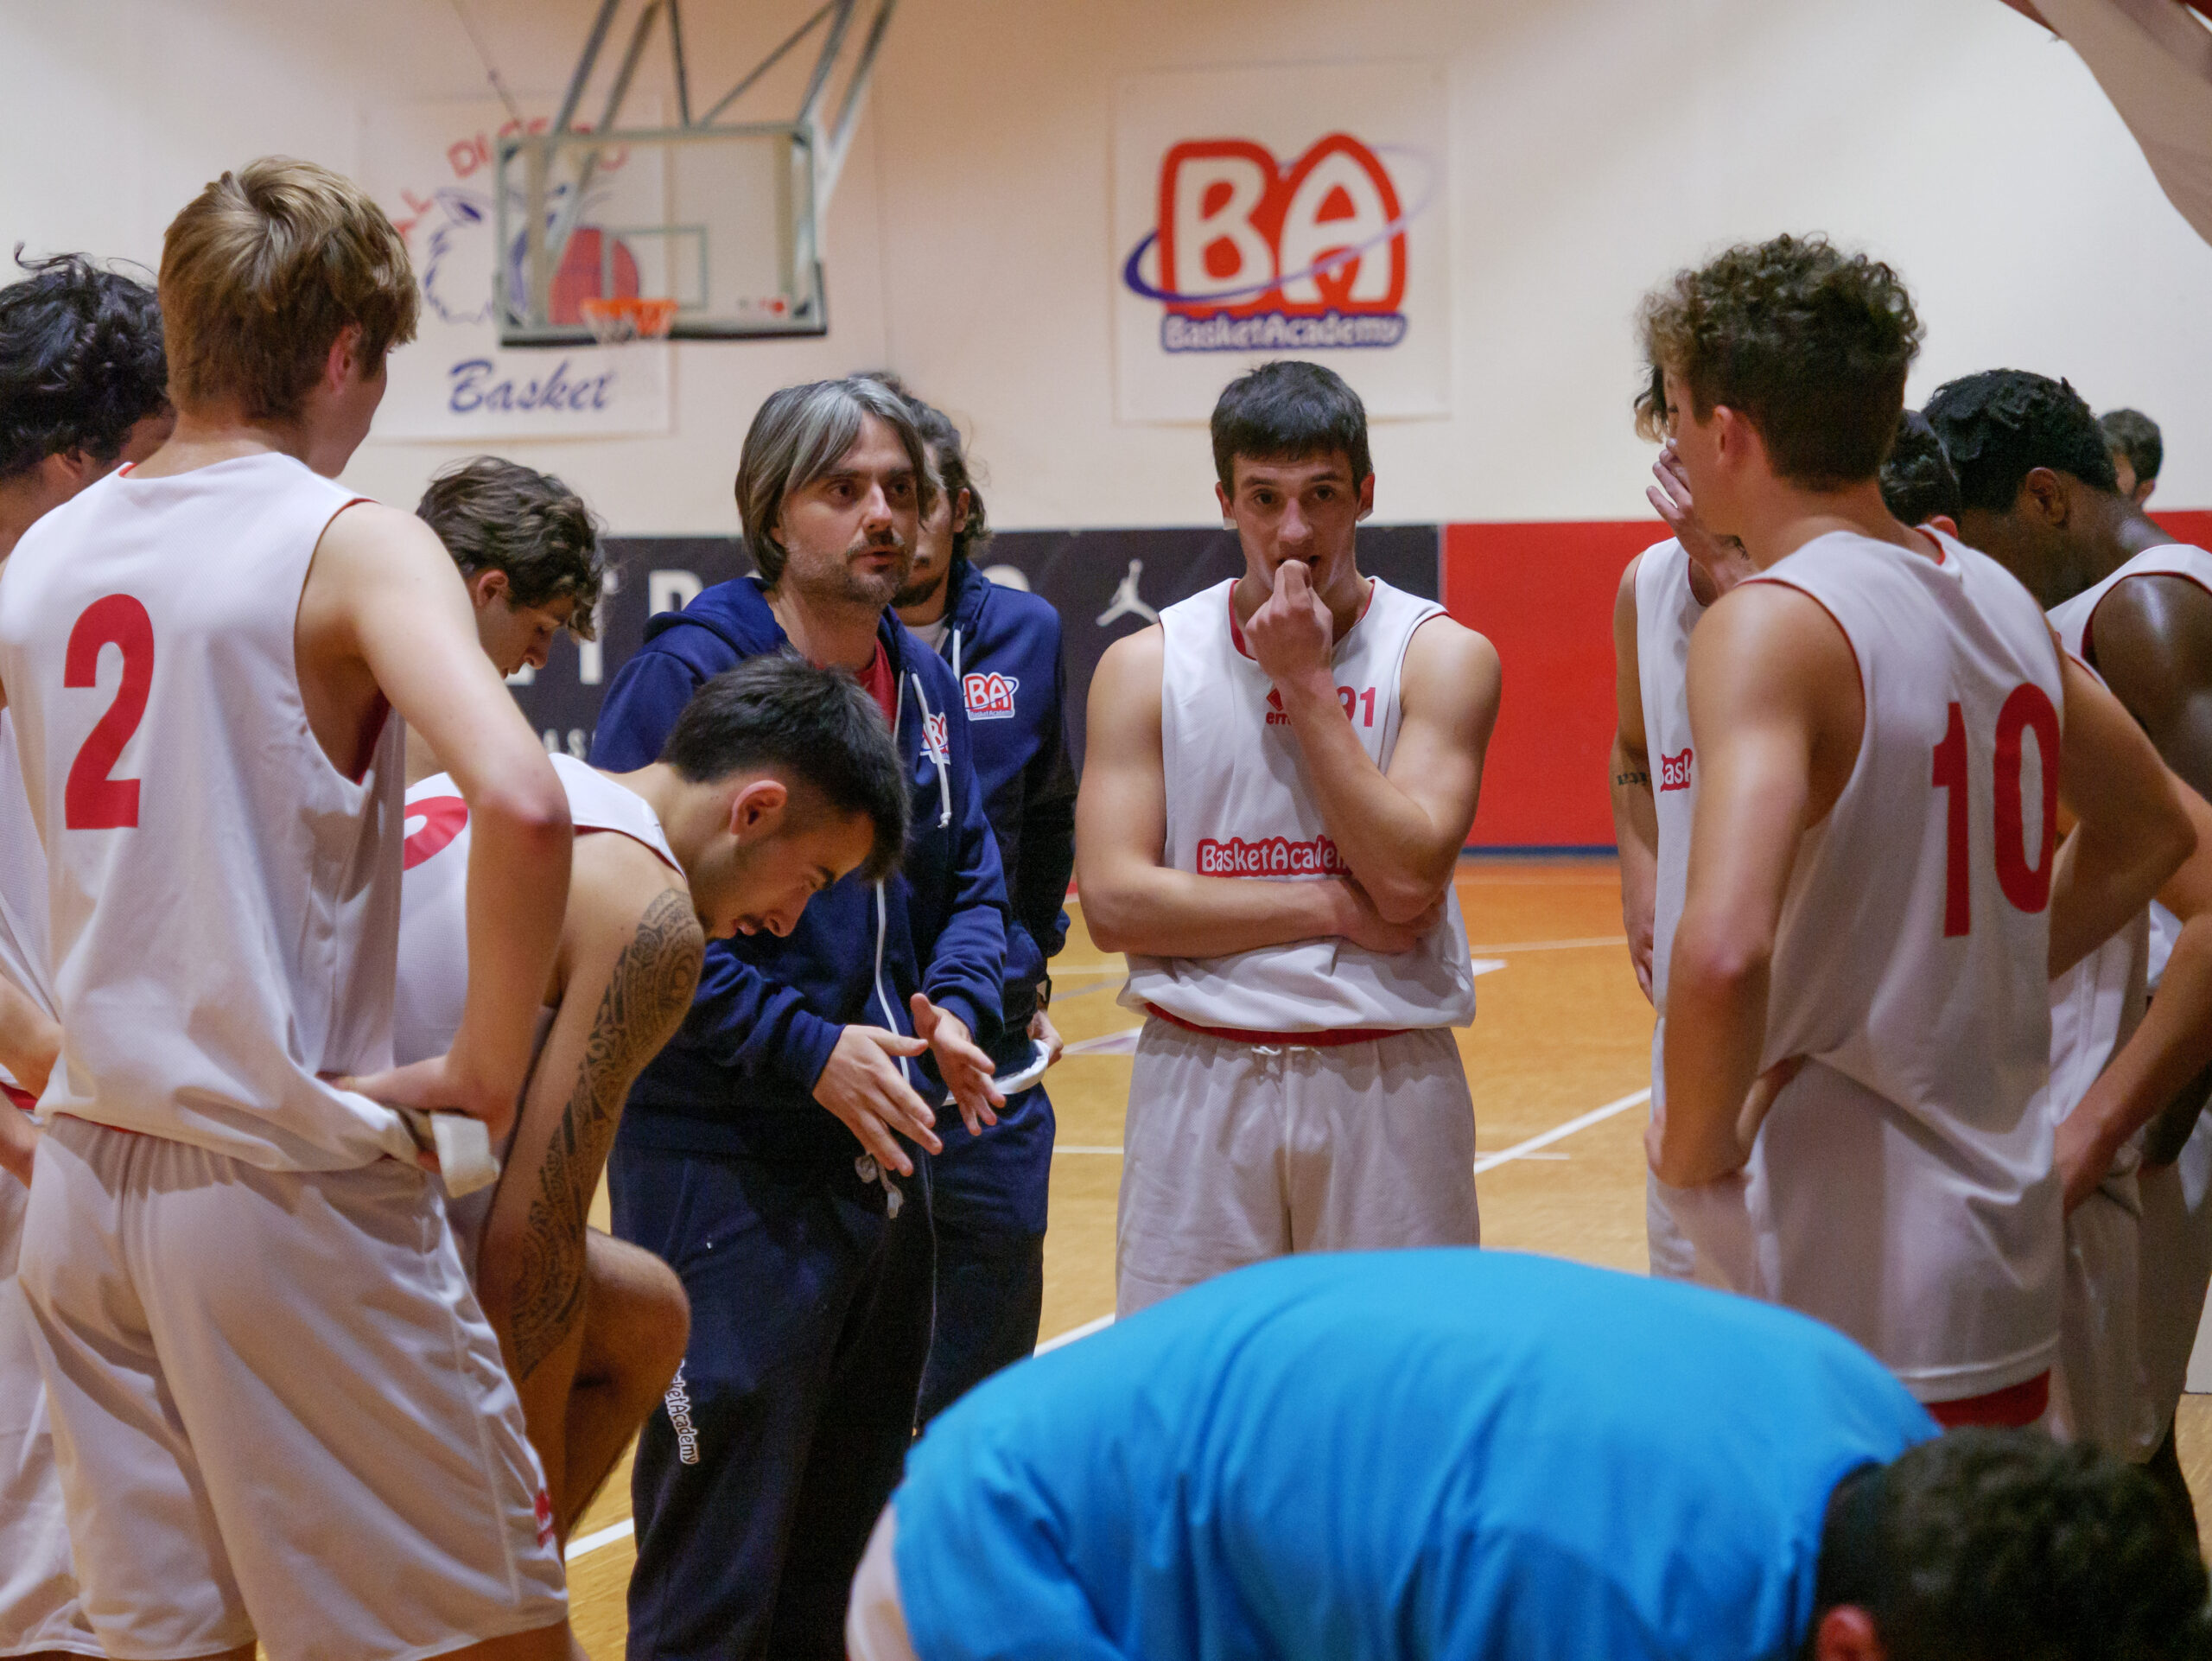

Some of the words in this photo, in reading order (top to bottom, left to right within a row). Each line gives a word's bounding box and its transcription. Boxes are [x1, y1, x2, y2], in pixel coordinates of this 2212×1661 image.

[1165, 141, 1400, 309] BA
[449, 359, 613, 416] Basket
[64, 593, 155, 830] 2
[966, 675, 1011, 711] BA
[1198, 838, 1349, 874] BasketAcade
[1931, 682, 2061, 938] 10
